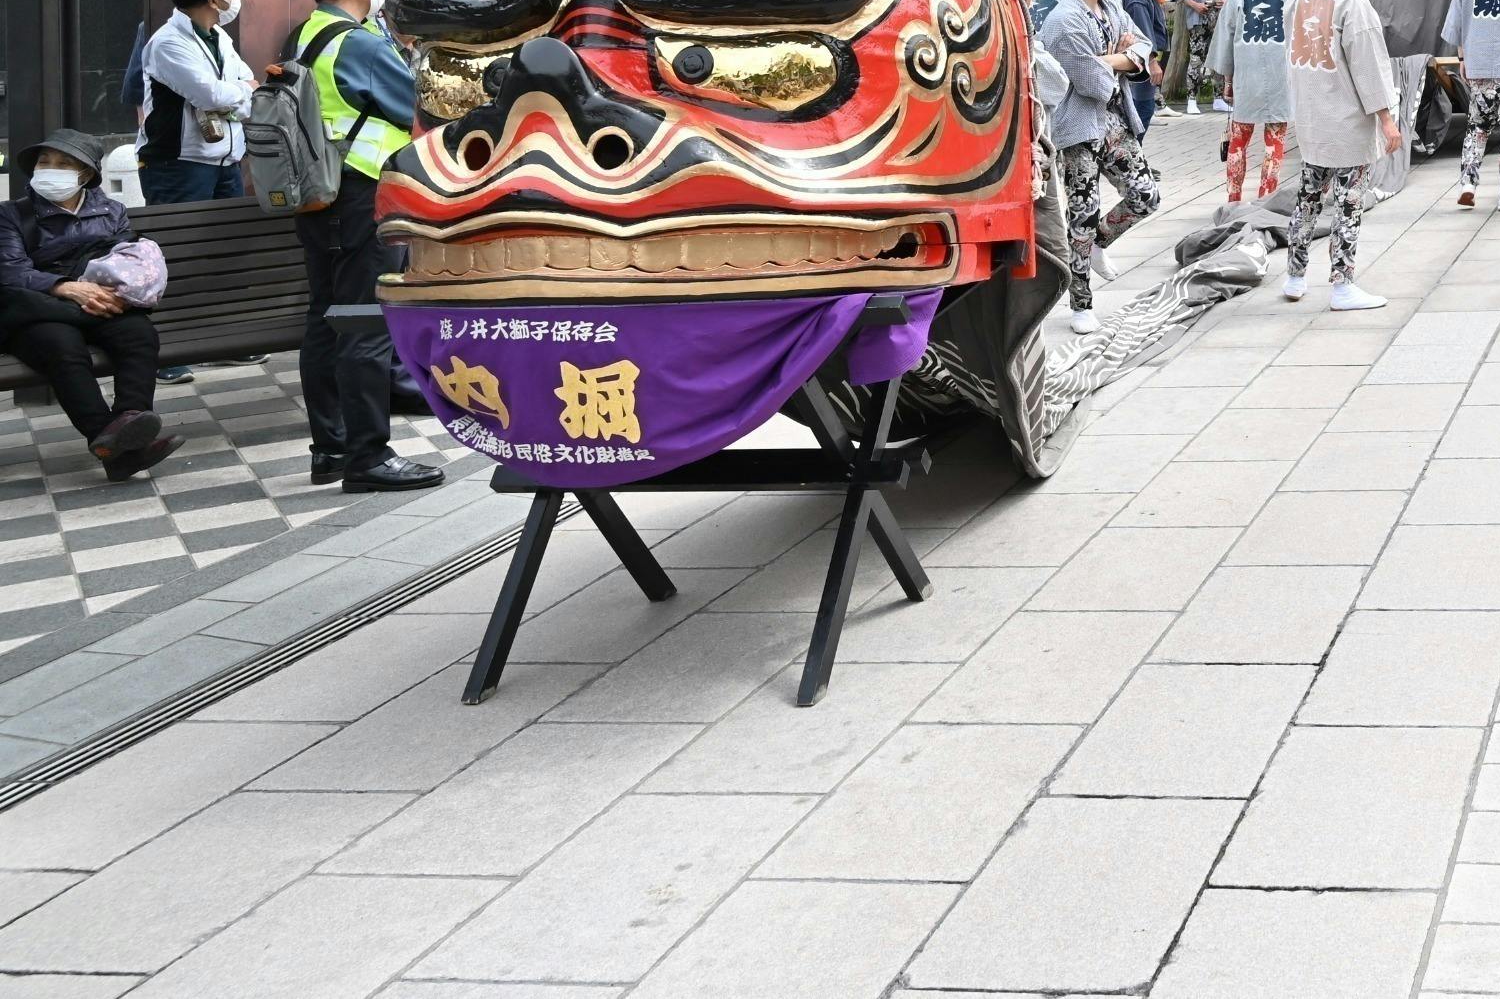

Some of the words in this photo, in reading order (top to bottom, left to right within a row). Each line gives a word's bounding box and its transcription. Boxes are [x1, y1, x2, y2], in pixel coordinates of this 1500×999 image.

[439, 318, 619, 343] 篠ノ井大獅子保存会
[447, 414, 656, 465] 長野市無形民俗文化財指定
